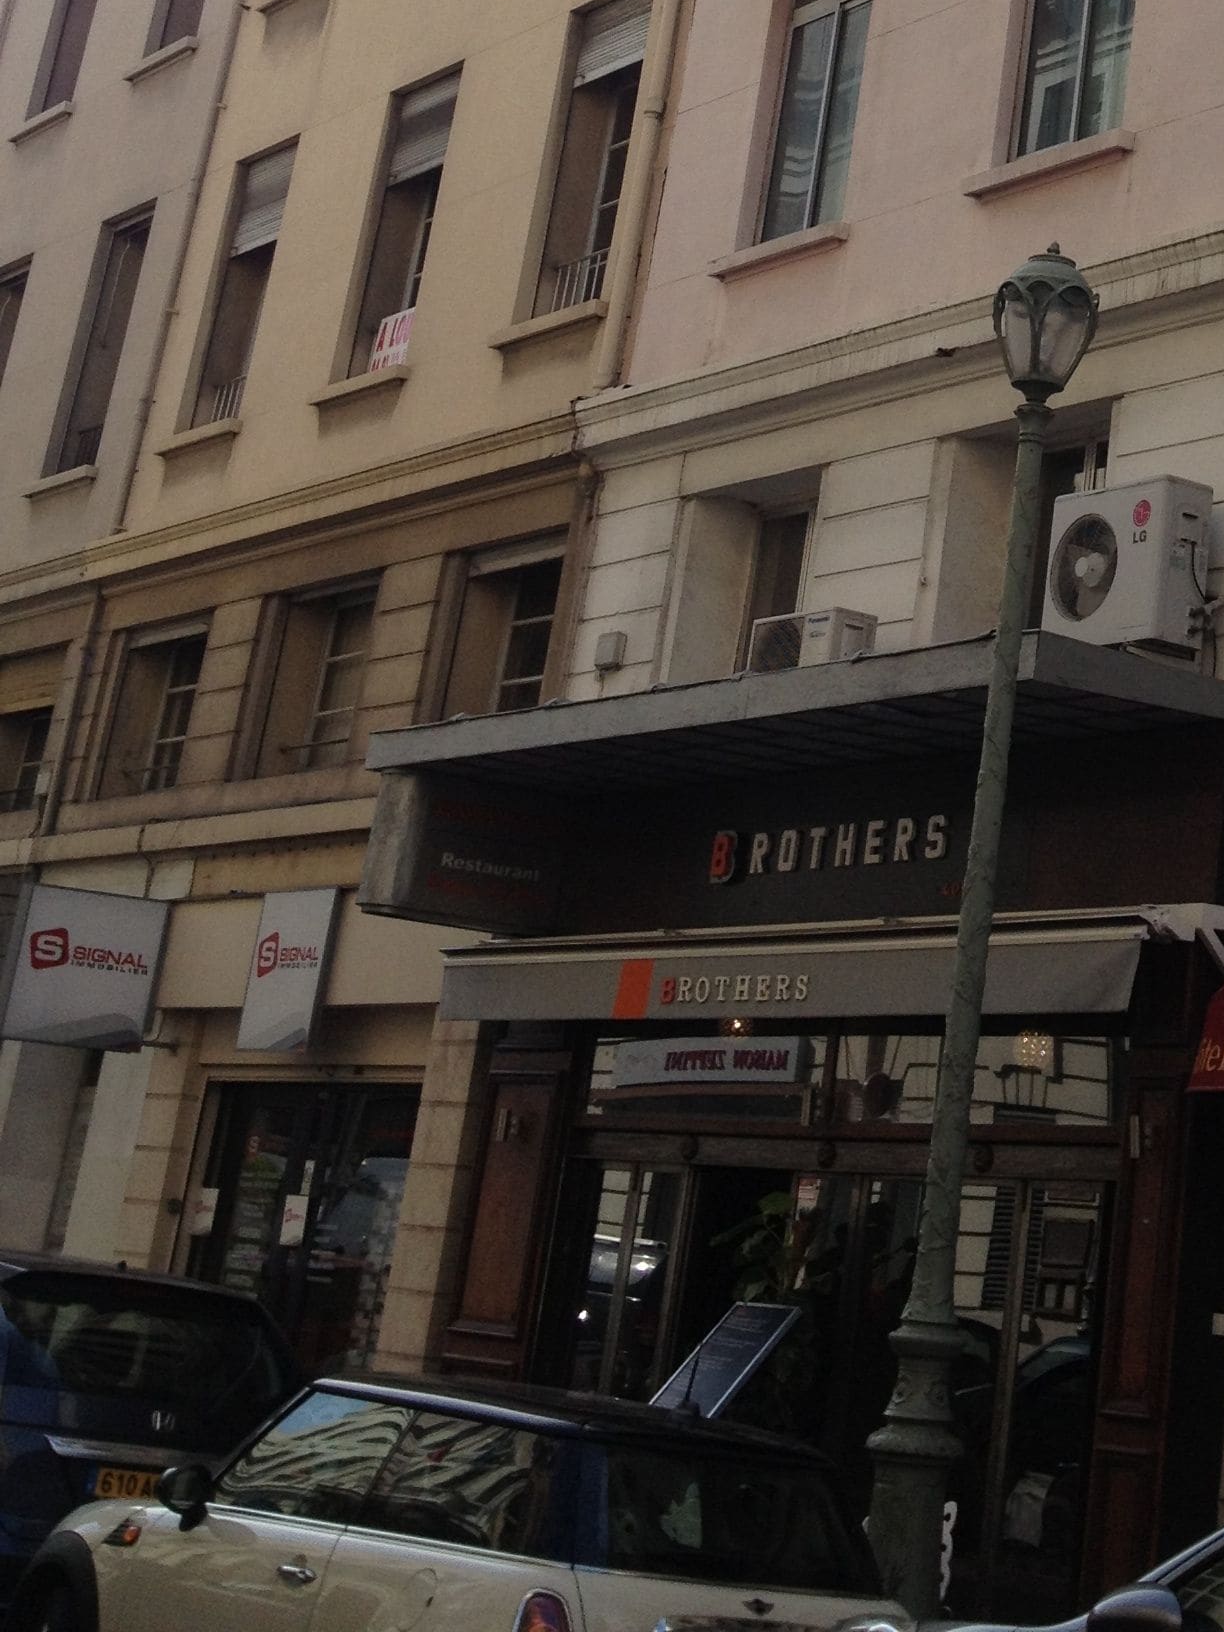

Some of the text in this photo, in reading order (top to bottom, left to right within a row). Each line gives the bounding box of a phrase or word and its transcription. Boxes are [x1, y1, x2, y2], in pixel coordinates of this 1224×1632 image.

[1132, 530, 1147, 544] LG
[708, 815, 948, 884] BROTHERS
[441, 852, 540, 882] Restaurant
[73, 946, 148, 969] SIGNAL
[280, 946, 318, 961] SIGNAL
[659, 974, 809, 1006] BROTHERS
